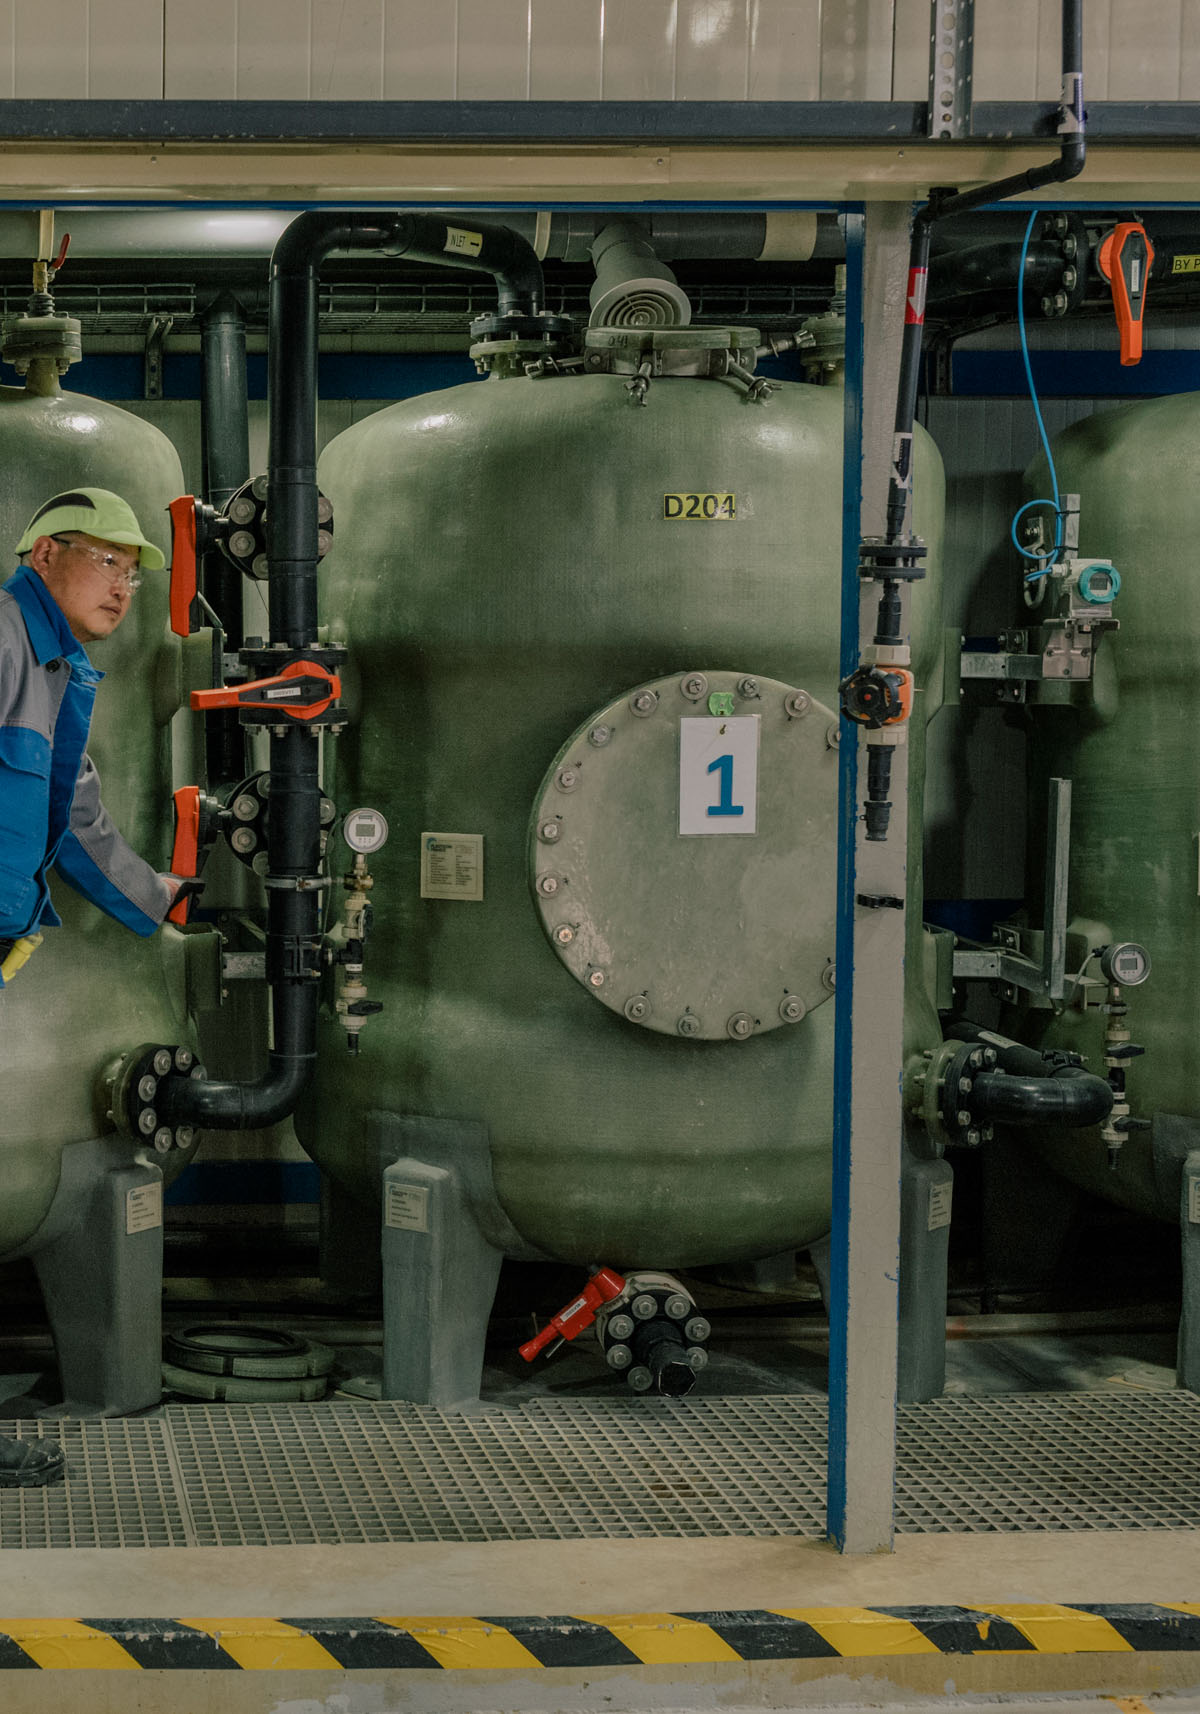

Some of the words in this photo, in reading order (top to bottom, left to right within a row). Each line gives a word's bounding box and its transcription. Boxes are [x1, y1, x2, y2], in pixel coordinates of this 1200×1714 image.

[1175, 258, 1191, 270] BY
[664, 494, 736, 519] D204
[707, 754, 745, 816] 1
